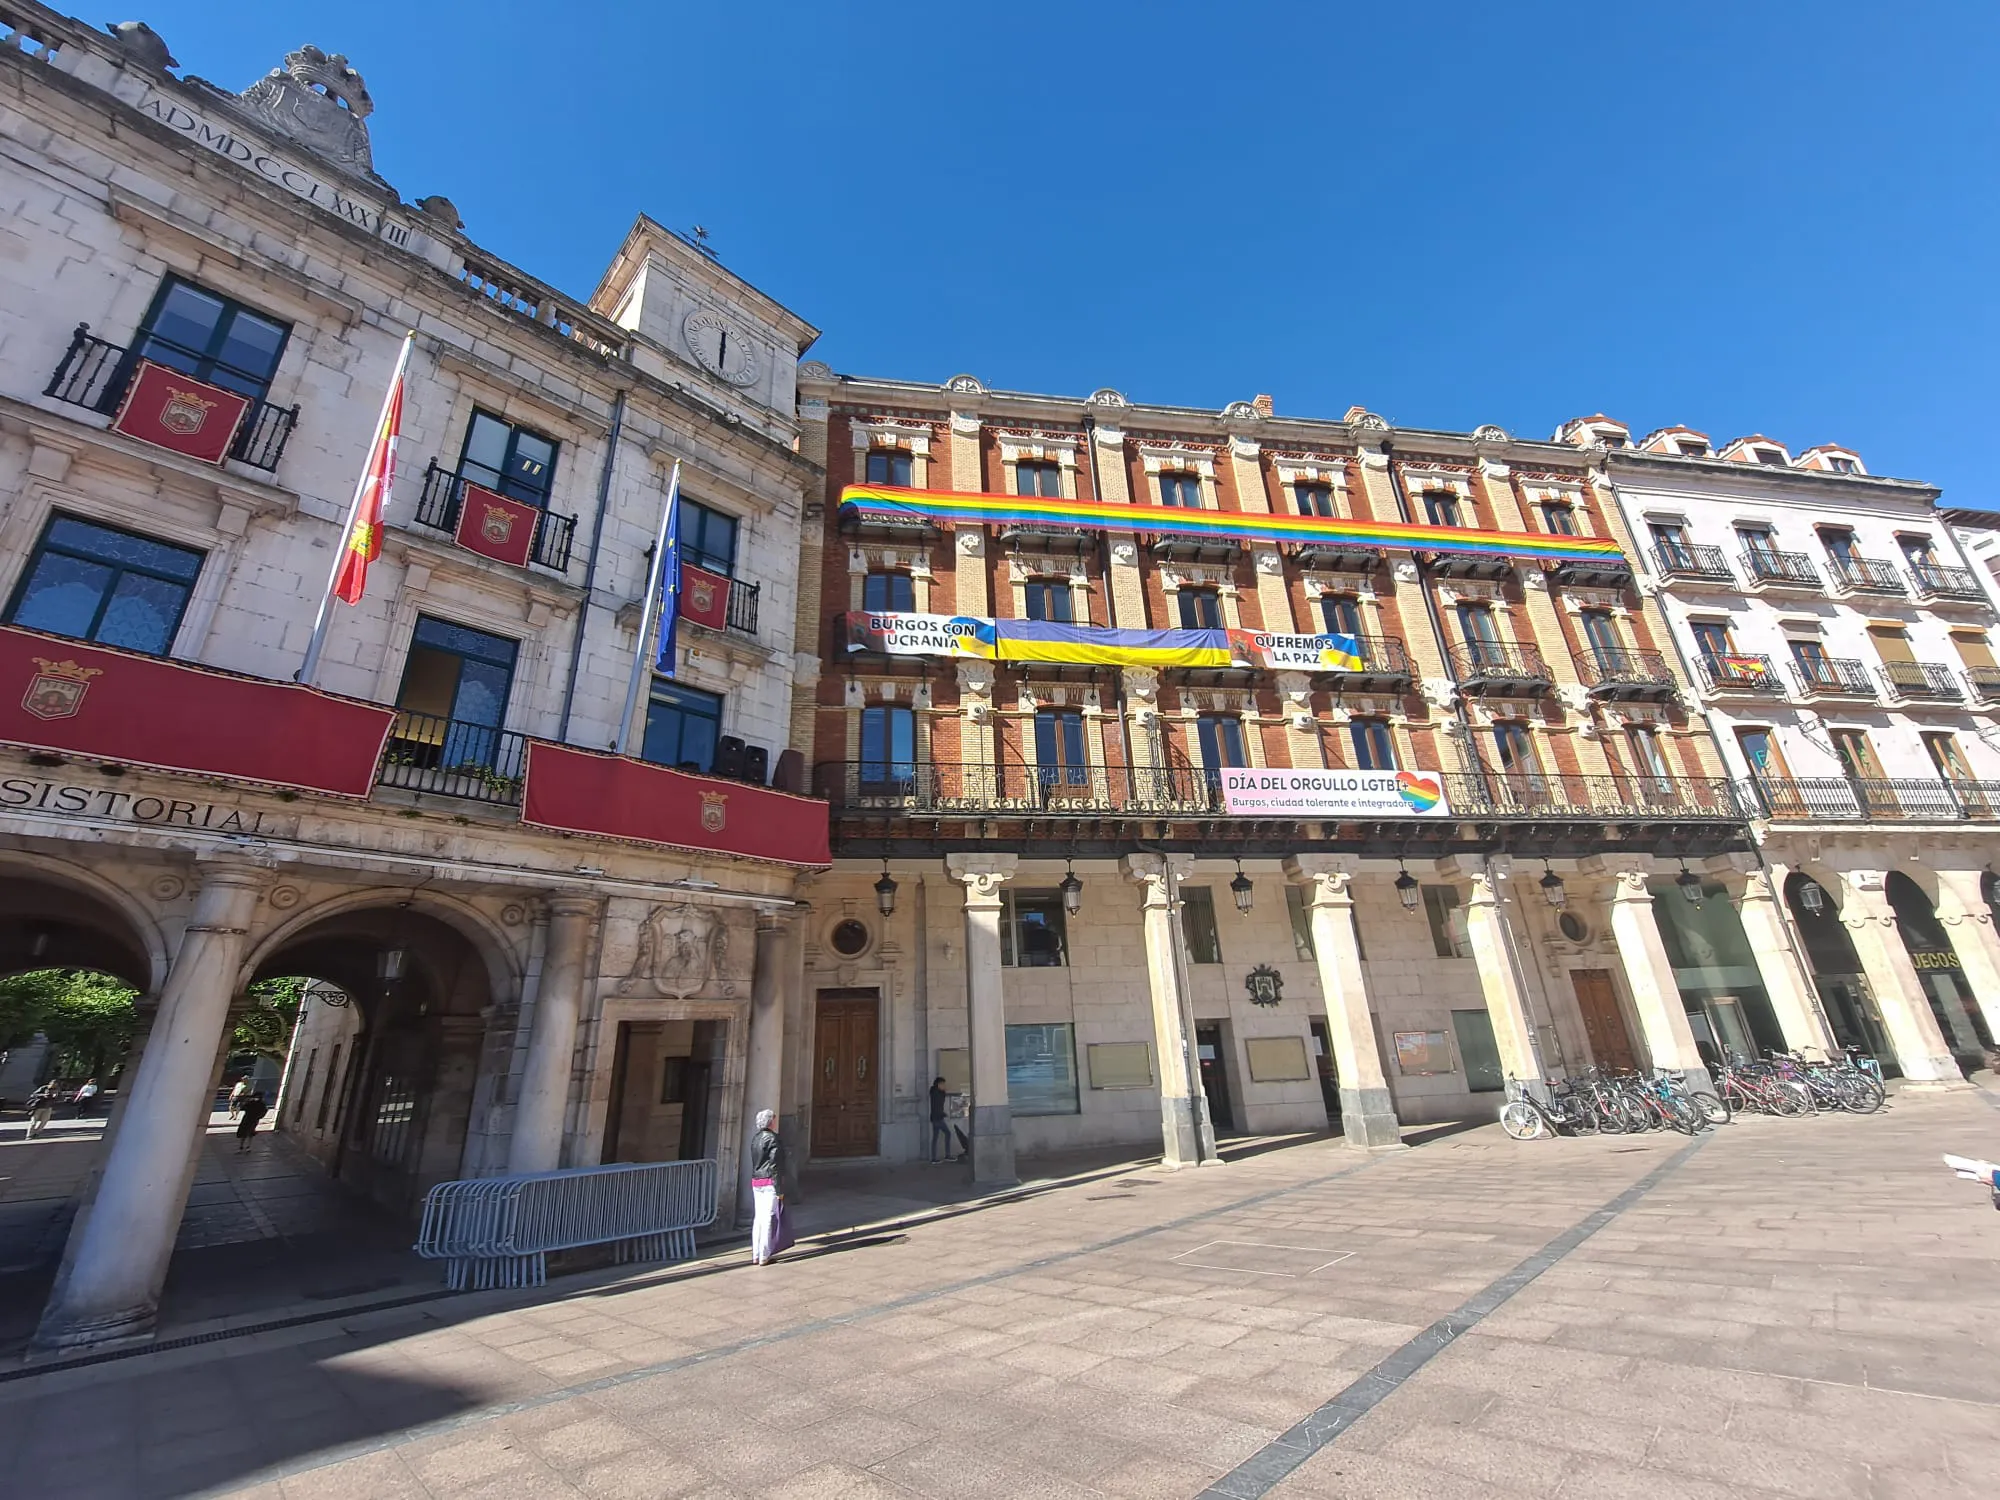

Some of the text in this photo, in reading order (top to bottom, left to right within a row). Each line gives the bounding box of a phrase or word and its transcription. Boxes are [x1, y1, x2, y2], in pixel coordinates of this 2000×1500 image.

[871, 618, 976, 637] BURGOS CON
[887, 634, 960, 649] UCRANIA
[1255, 636, 1333, 650] QUEREMOS
[1273, 651, 1321, 664] LA PAZ
[1228, 772, 1409, 792] DÍA DEL ORGULLO LGTBI+
[1232, 797, 1414, 809] Burgos, ciudad tolerante e integradora
